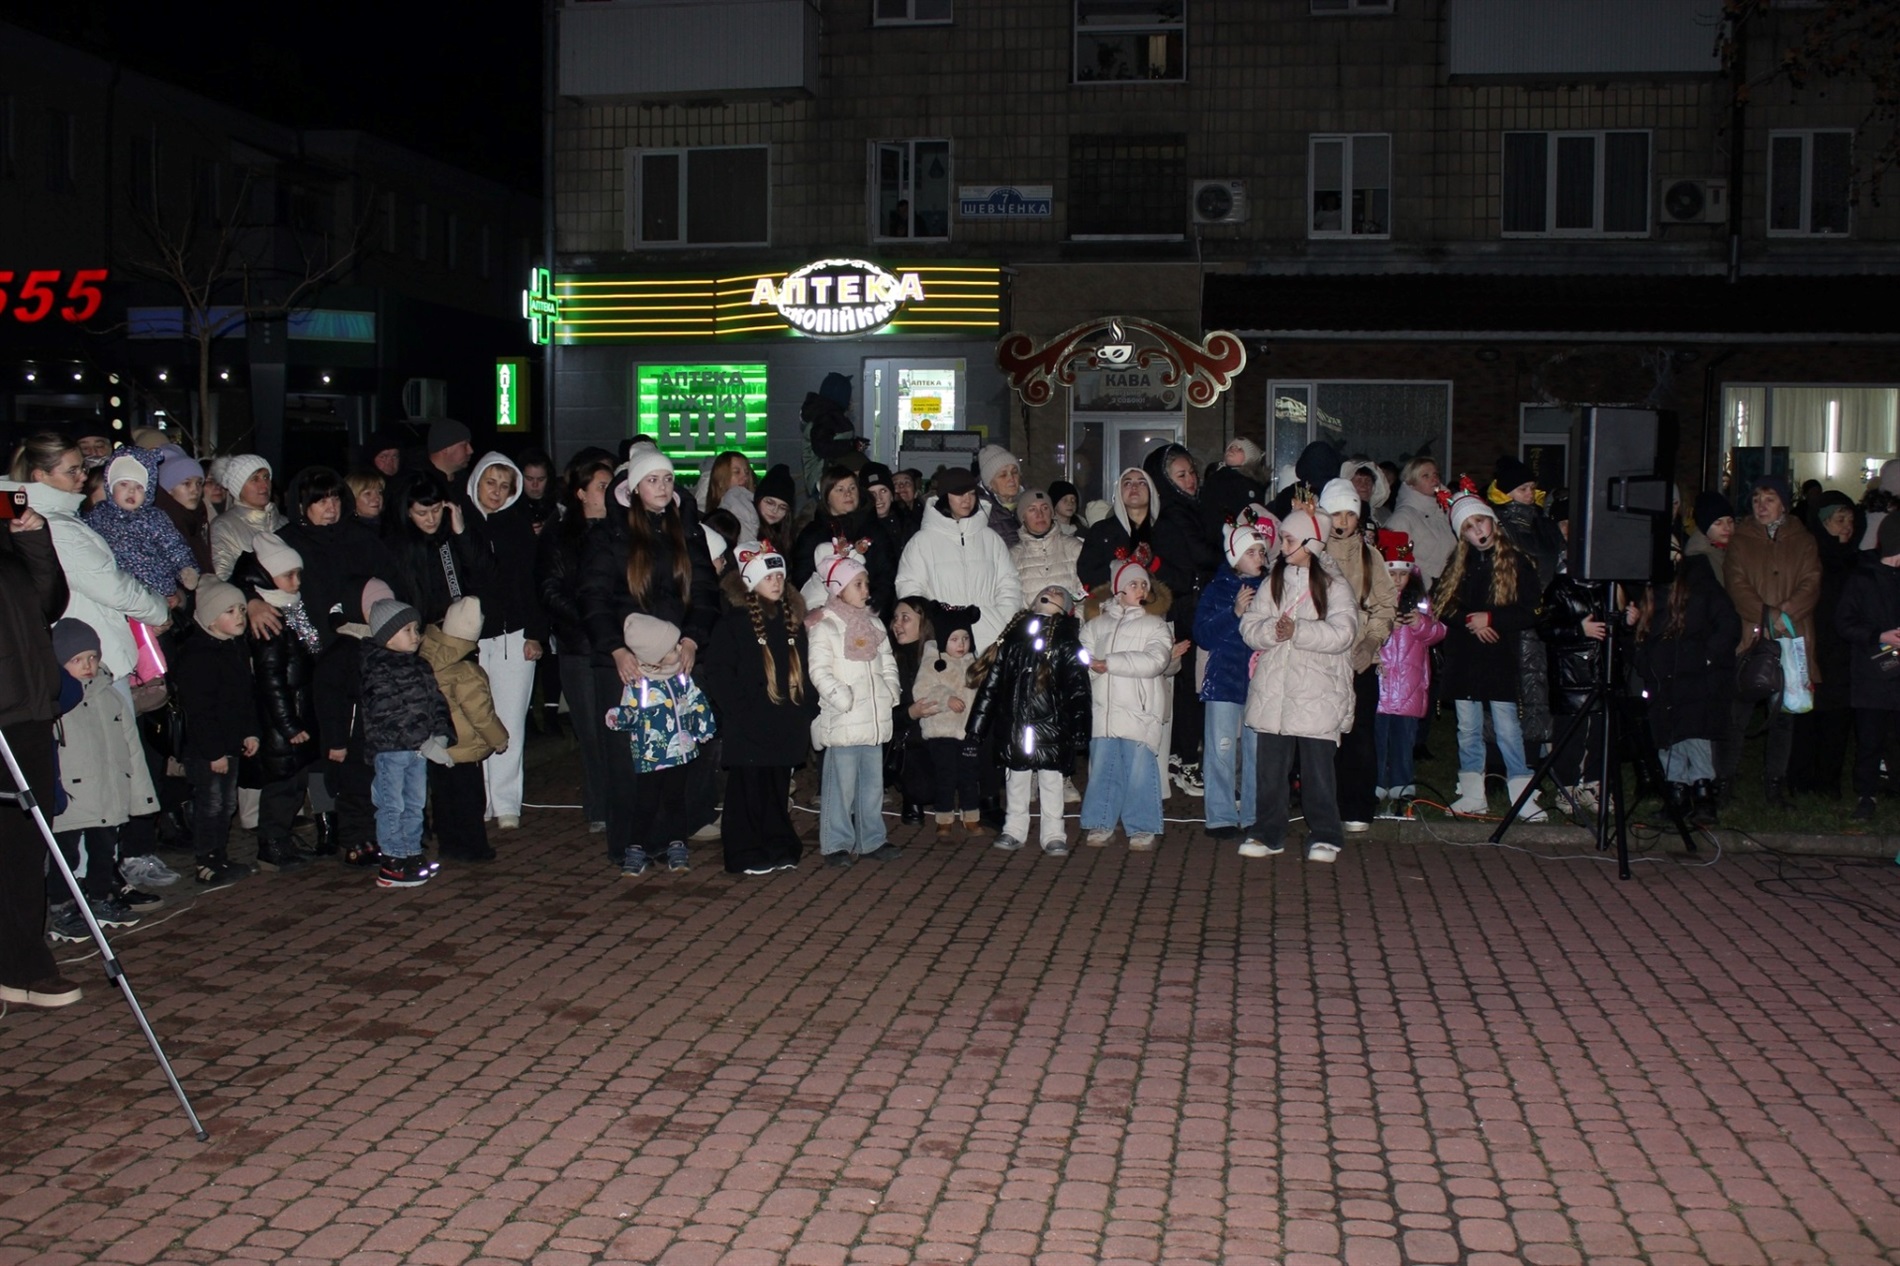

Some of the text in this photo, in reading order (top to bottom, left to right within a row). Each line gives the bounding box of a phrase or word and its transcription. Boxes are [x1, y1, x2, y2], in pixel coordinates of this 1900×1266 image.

[964, 203, 1048, 214] ШЕВЧЕНКА
[1001, 194, 1009, 204] 7
[0, 268, 109, 323] 55
[752, 273, 925, 305] АПТЕКА
[530, 300, 556, 314] АПТЕКА
[660, 371, 745, 387] АПТЕКА
[1105, 374, 1151, 387] КАВА
[499, 363, 511, 425] АПТЕКА
[659, 411, 746, 451] ЦІН
[442, 544, 454, 574] ICHAEL
